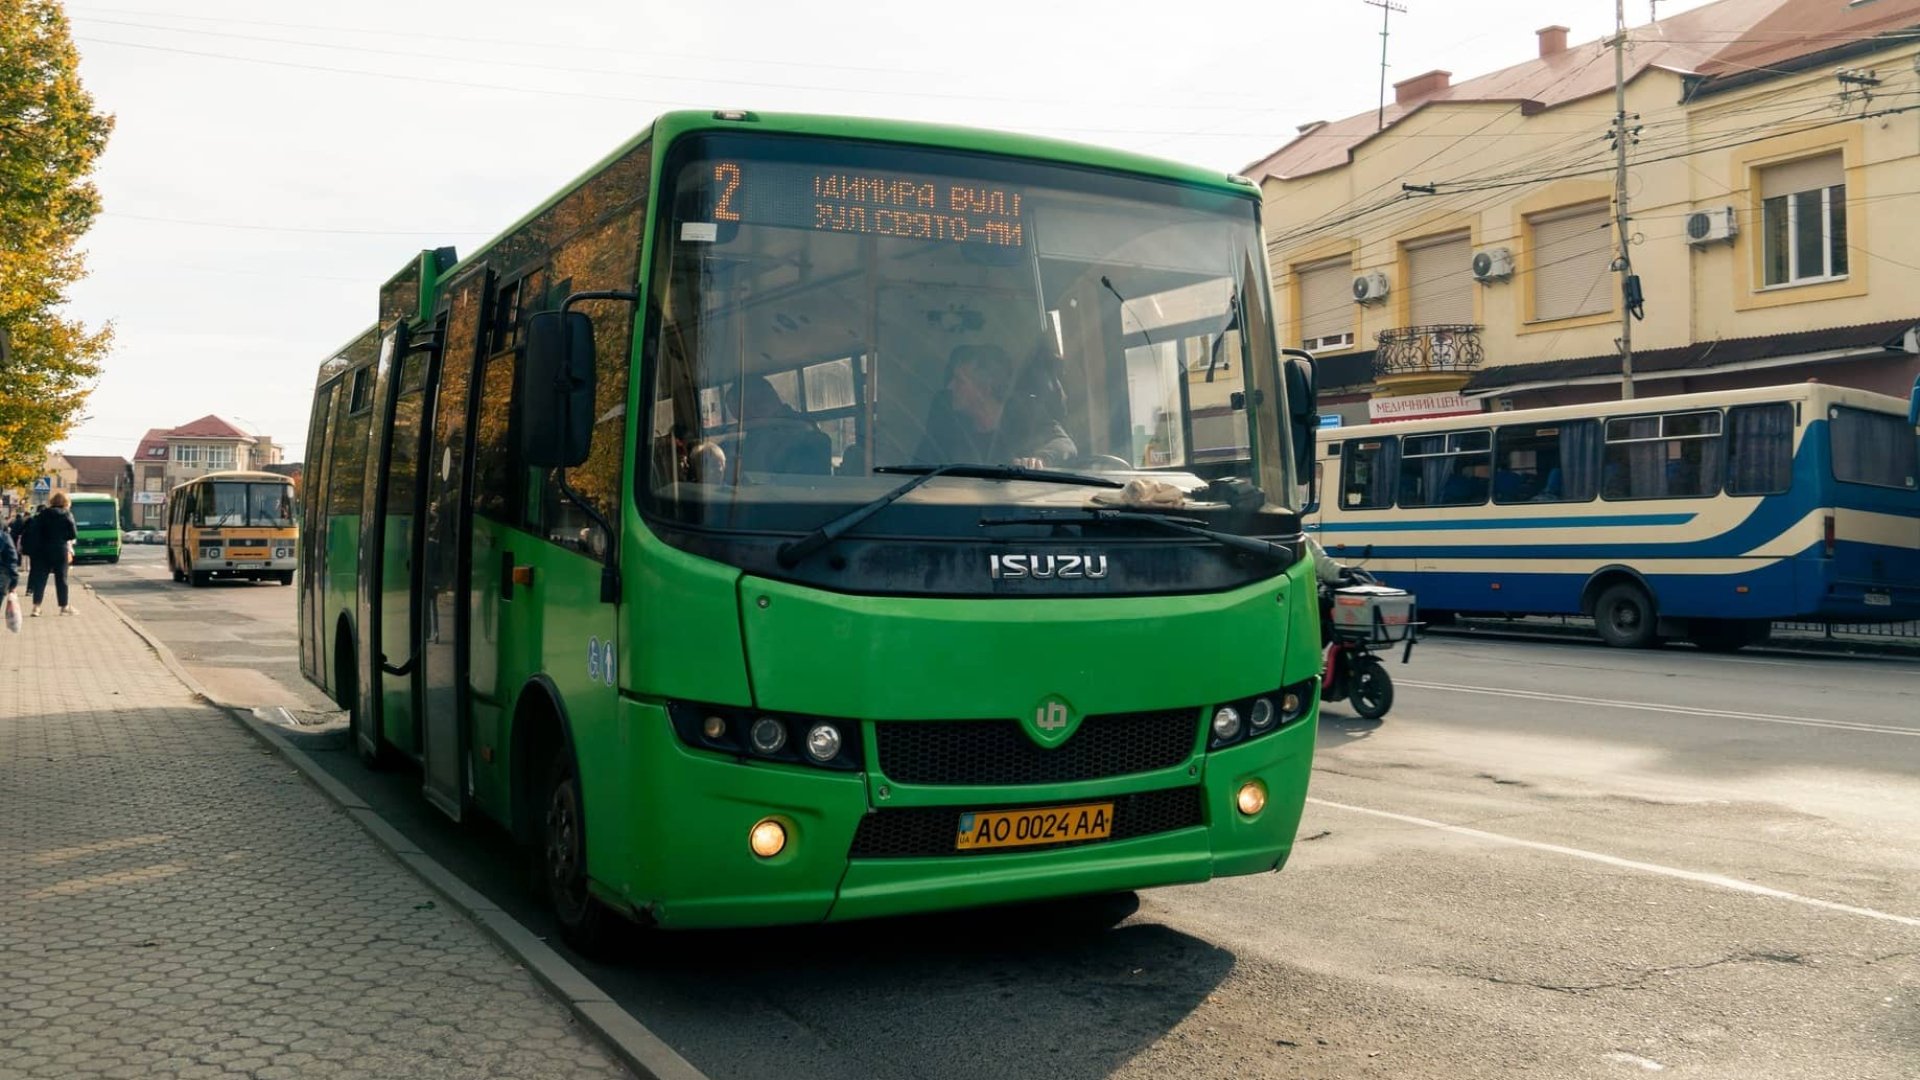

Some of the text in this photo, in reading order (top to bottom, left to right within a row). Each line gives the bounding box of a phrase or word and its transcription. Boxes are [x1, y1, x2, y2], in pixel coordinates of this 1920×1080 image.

[714, 163, 740, 221] 2
[1376, 397, 1435, 413] МЕДИЧНИЙ
[990, 554, 1108, 579] ISUZU
[1016, 811, 1071, 840] 0024
[1074, 807, 1106, 836] AA
